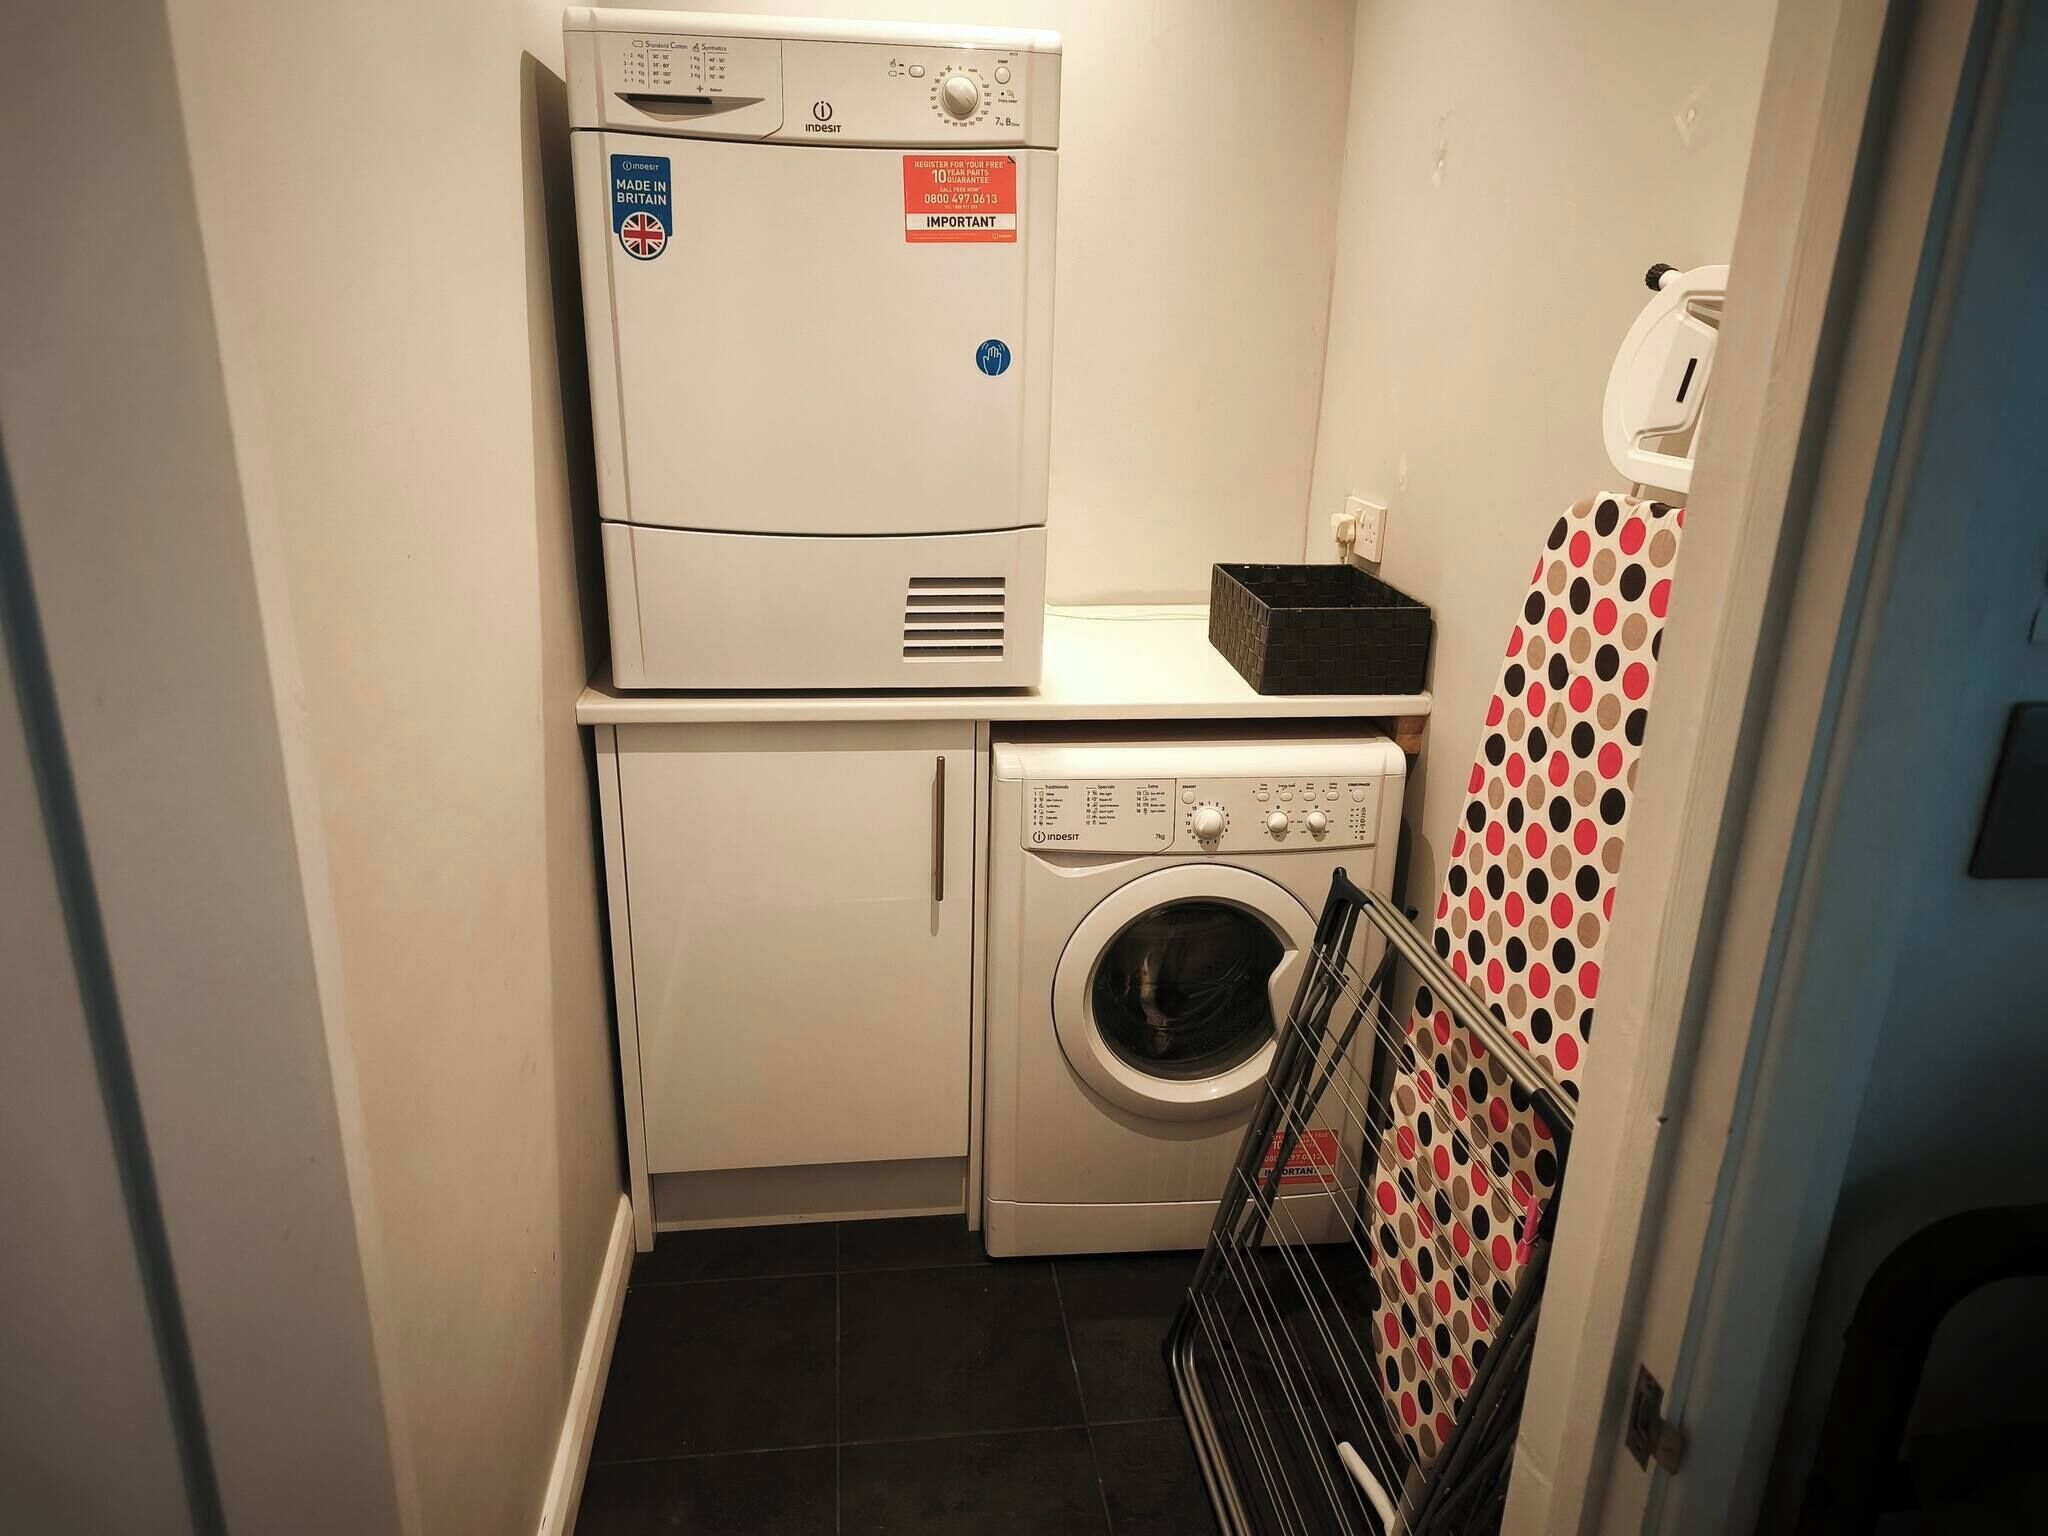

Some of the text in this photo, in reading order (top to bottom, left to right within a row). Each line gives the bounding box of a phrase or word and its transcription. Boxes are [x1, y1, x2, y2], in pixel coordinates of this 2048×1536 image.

[806, 124, 841, 132] INDESIT
[932, 169, 946, 183] 10
[616, 179, 666, 192] MADE IN
[617, 192, 667, 205] BRITAIN
[924, 193, 998, 203] 0800 497 0613
[927, 216, 996, 227] IMPORTANT
